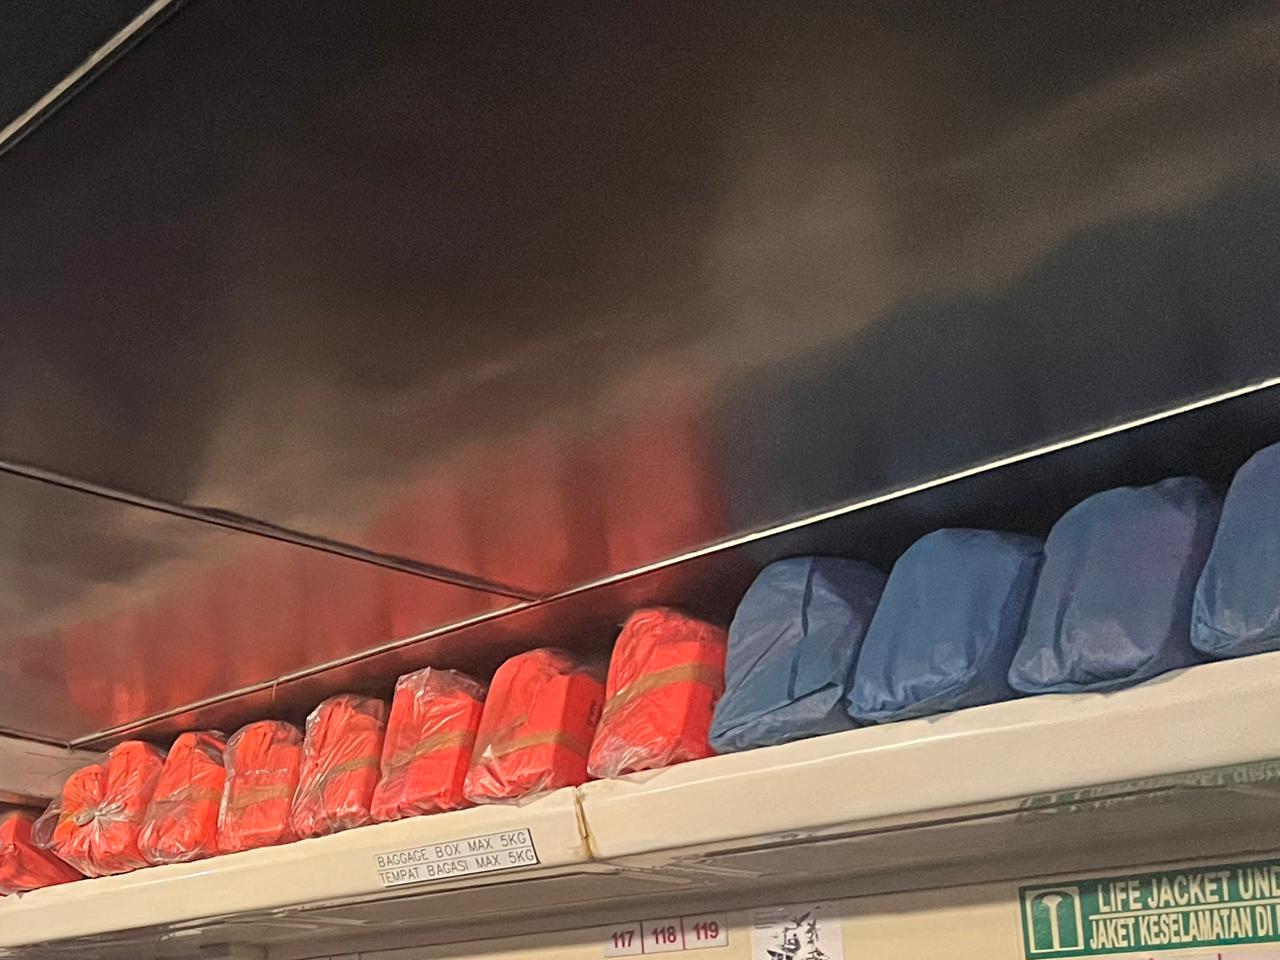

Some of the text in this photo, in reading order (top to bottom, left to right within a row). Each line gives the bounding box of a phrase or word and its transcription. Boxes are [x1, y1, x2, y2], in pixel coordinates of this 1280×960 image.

[377, 831, 527, 868] BAGGAGE BOX MAX 5KG
[379, 849, 535, 884] TEMPAT BAGASI MAX 5KG
[1097, 880, 1143, 913] LIFE
[1147, 870, 1231, 909] JACKET
[610, 921, 719, 949] 117 118 119
[1089, 915, 1136, 950] JAKET
[1139, 906, 1253, 947] KESELAMATAN
[1256, 905, 1273, 937] DI
